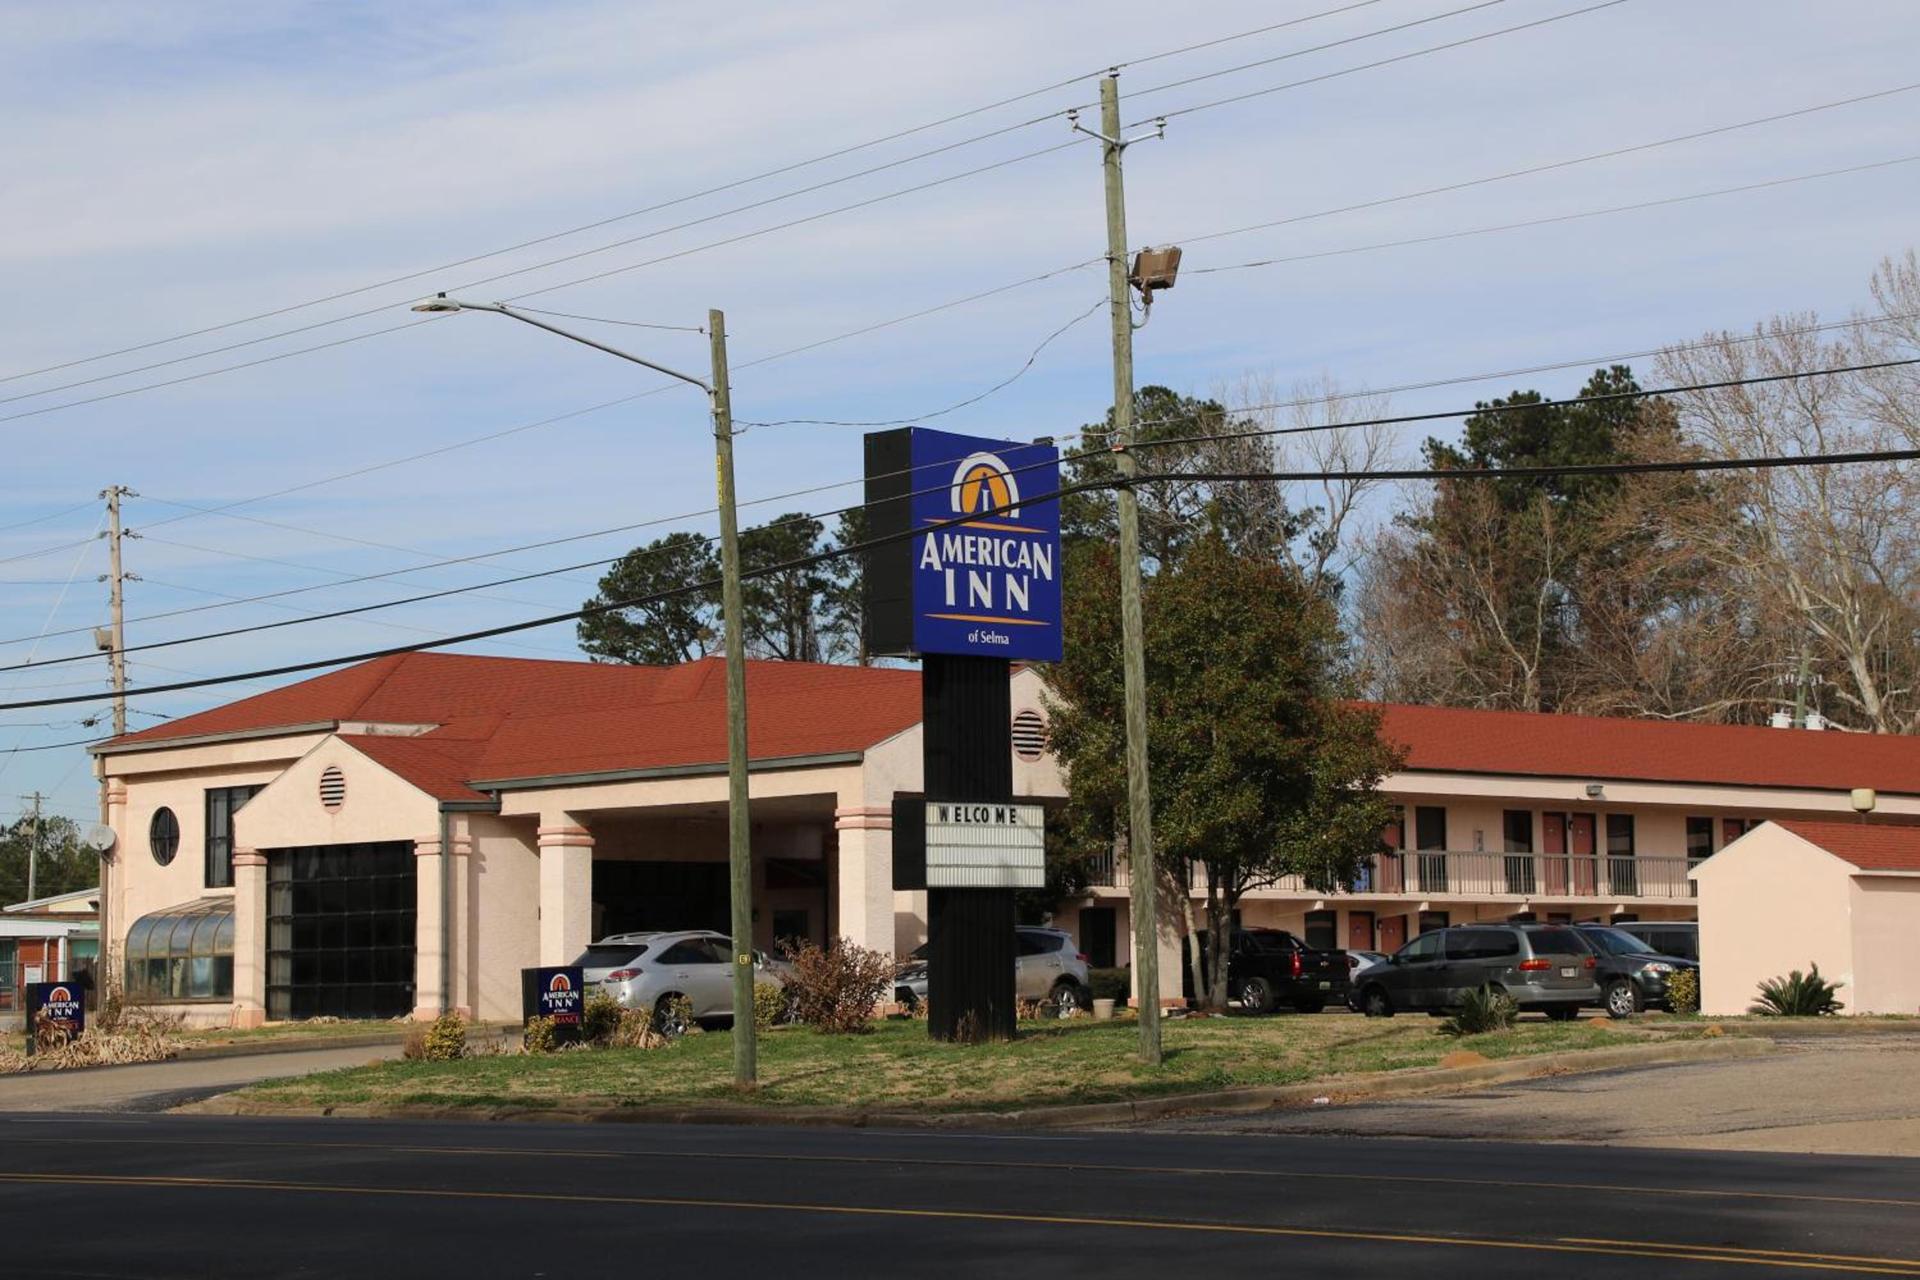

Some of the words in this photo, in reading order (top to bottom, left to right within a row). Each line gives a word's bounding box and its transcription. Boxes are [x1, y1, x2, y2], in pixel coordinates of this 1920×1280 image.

[919, 531, 1053, 581] AMERICAN
[945, 568, 1030, 612] INN
[968, 630, 979, 644] of
[980, 631, 1010, 645] Selma
[939, 806, 1017, 824] WELCOME
[542, 990, 580, 1002] AMERICAN
[548, 999, 573, 1008] INN
[48, 1008, 73, 1017] INN
